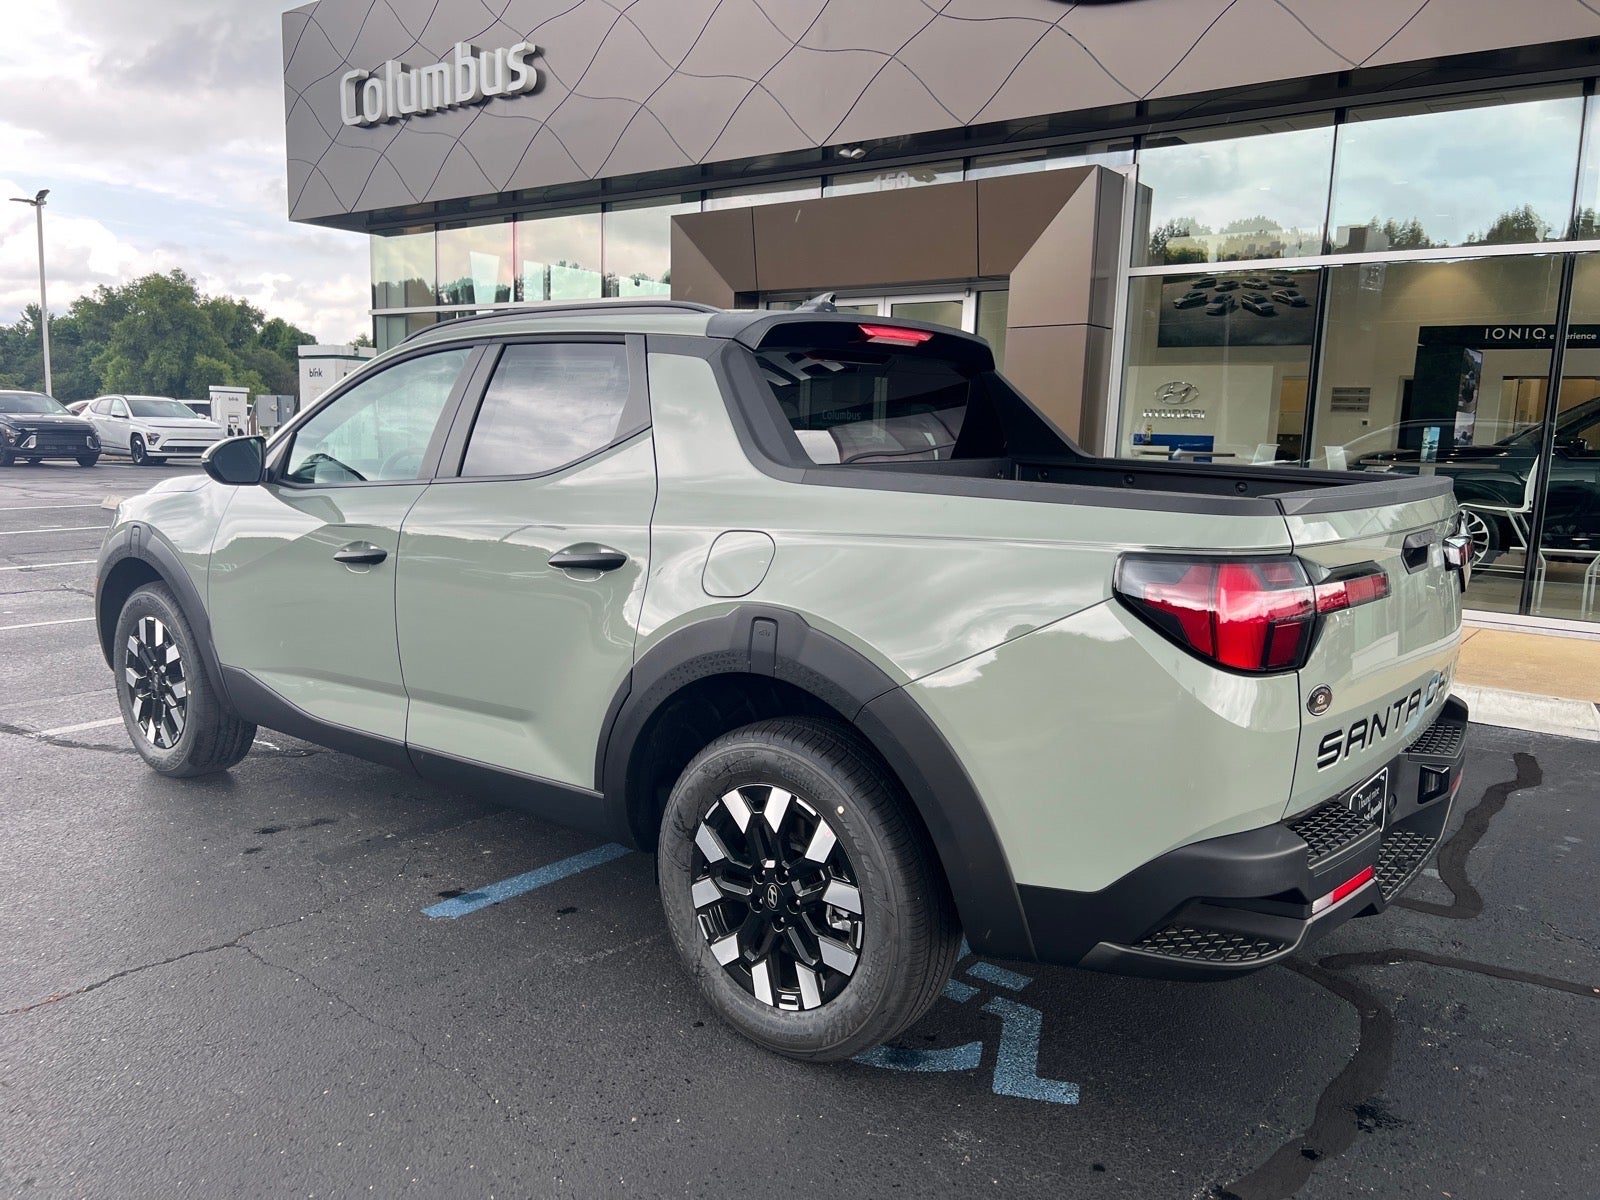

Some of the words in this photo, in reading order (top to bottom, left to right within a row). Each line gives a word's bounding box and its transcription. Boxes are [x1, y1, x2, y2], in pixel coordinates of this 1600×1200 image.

[340, 41, 538, 126] Columbus
[1484, 327, 1547, 340] IONIQ
[1549, 331, 1597, 340] eerience
[308, 367, 323, 378] blink
[1142, 408, 1205, 420] HYUNDAI
[1317, 688, 1422, 772] SANTA
